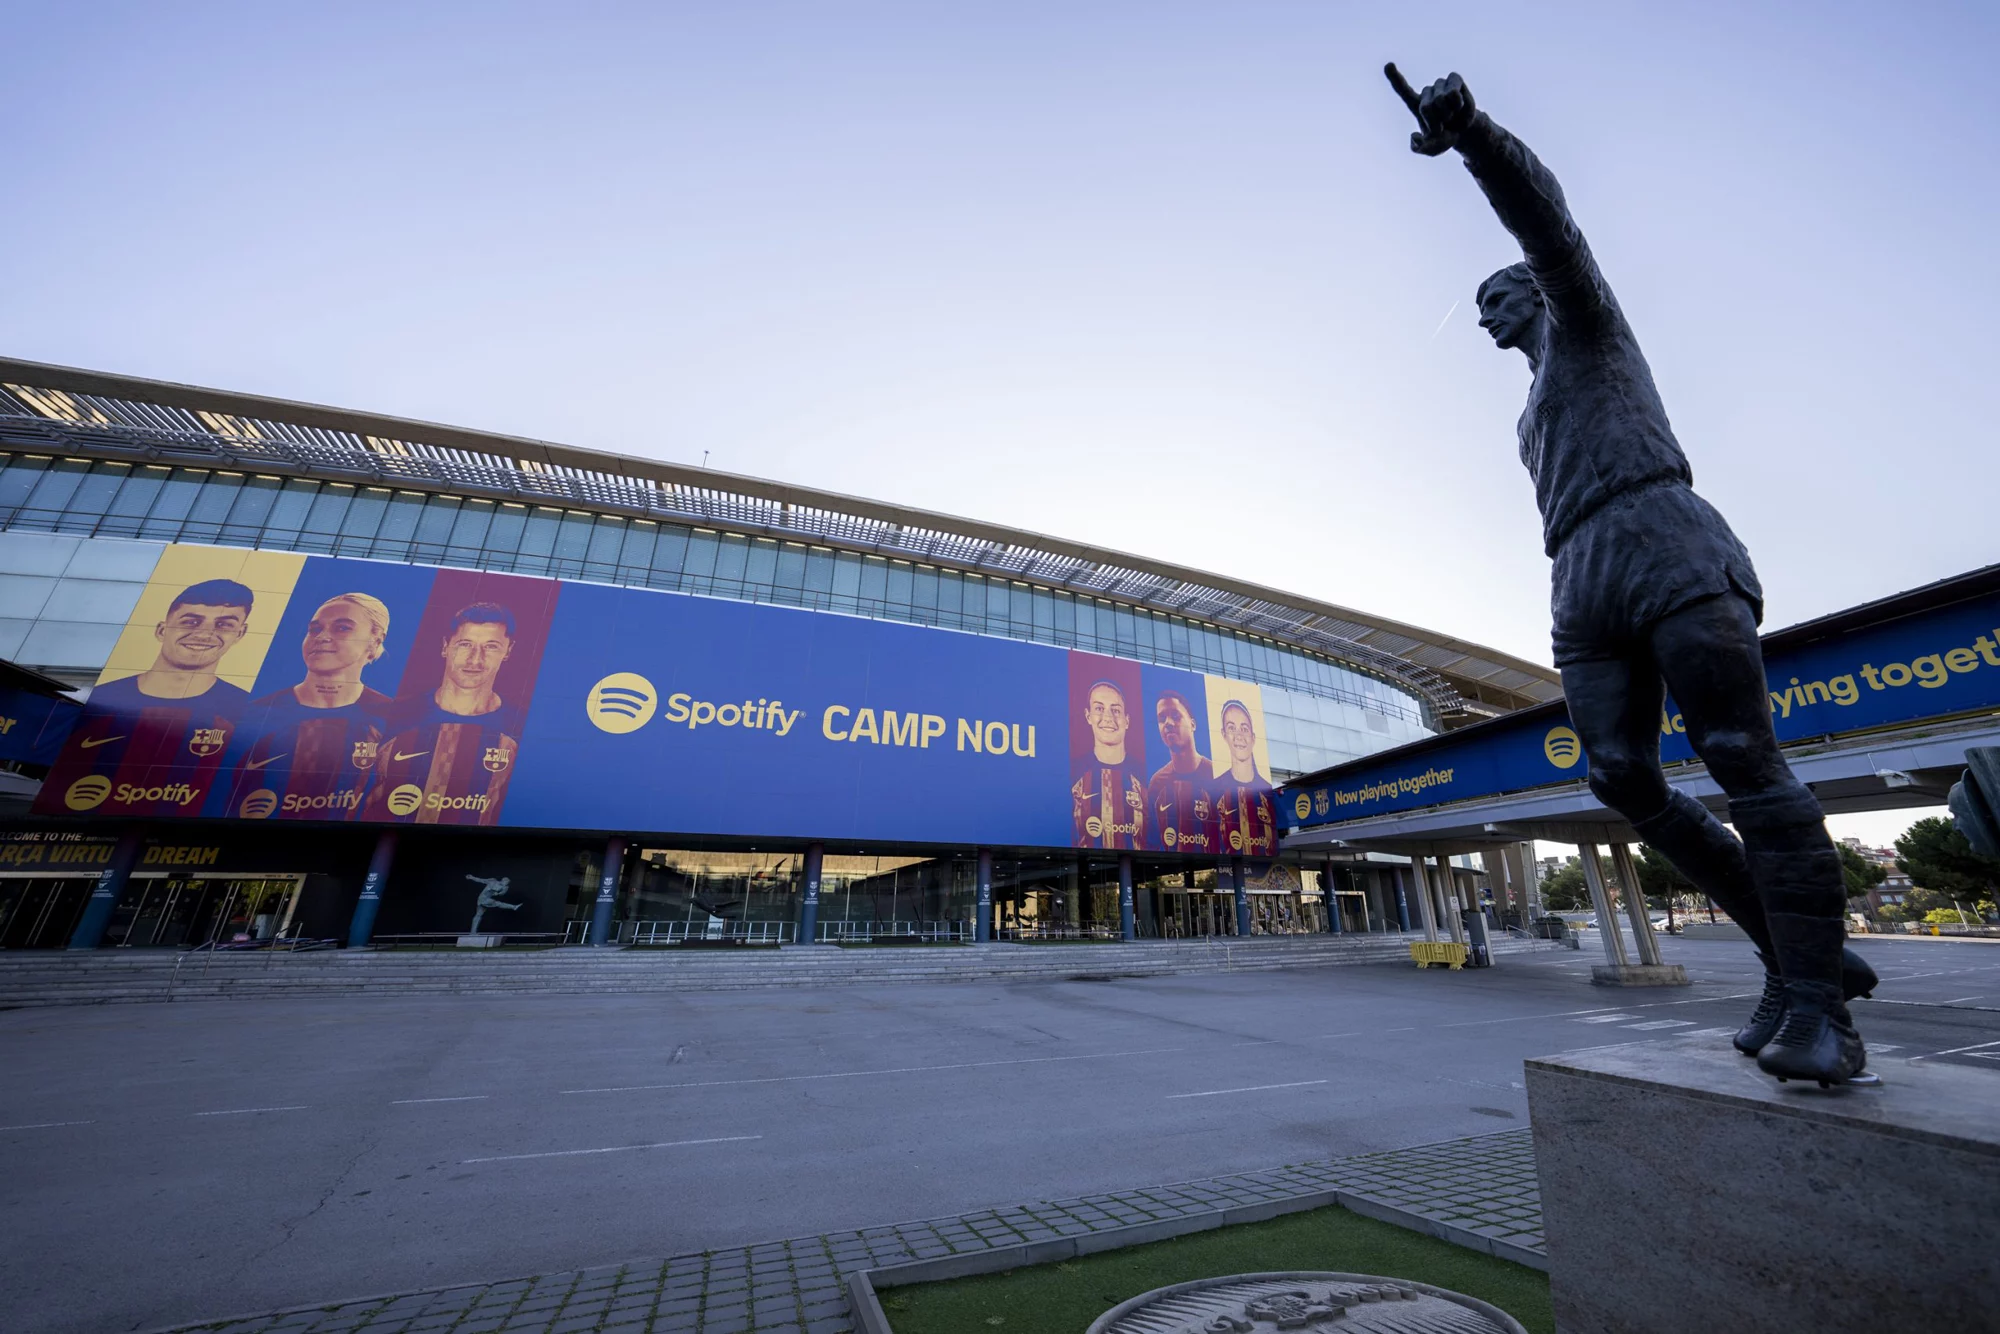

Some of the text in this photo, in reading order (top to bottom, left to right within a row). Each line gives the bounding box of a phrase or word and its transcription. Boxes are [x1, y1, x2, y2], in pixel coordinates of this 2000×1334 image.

[1769, 677, 1860, 718] ying
[822, 705, 946, 748] CAMP
[957, 718, 1036, 757] NOU
[113, 782, 201, 806] Spotify
[1335, 768, 1454, 806] Now playing together
[282, 789, 364, 812] Spotify
[425, 792, 492, 813] Spotify
[43, 832, 59, 841] TO
[60, 832, 82, 842] THE
[1105, 822, 1140, 836] Spotify
[1178, 832, 1210, 847] Spotify
[1244, 837, 1270, 849] Spotify
[0, 844, 220, 866] RÇA VIRTU DREAM
